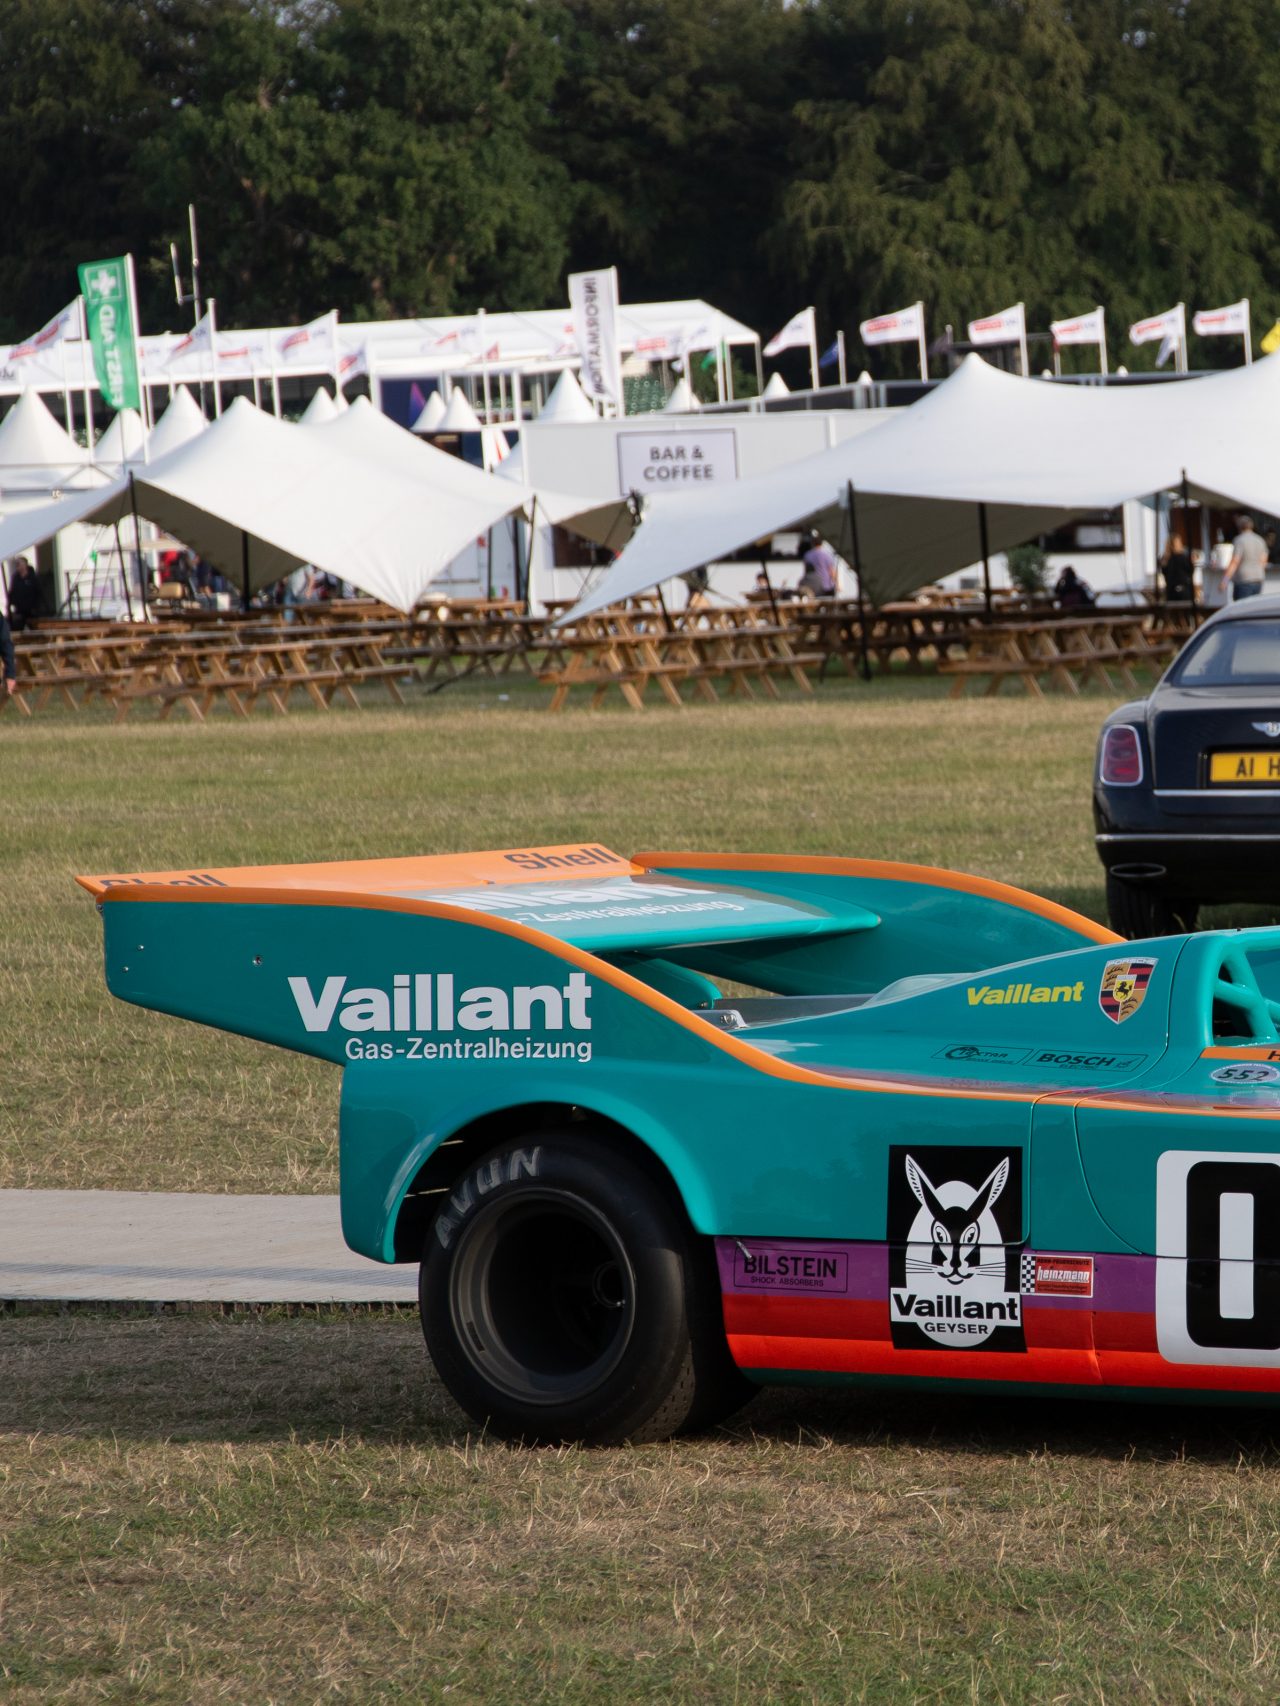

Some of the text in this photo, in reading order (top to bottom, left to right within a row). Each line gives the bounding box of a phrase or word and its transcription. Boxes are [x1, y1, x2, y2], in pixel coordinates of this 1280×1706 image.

[649, 445, 705, 461] BAR &
[643, 463, 714, 481] COFFEE
[503, 847, 621, 870] Shell
[287, 972, 592, 1032] Vaillant
[966, 981, 1085, 1007] Vaillant
[345, 1036, 593, 1063] Gas-Zentralheizung
[1036, 1053, 1117, 1067] BOSCH
[1217, 1068, 1270, 1082] 552
[434, 1145, 542, 1249] AVON
[743, 1254, 838, 1278] BILSTEIN
[1036, 1265, 1091, 1284] heinzmann
[892, 1293, 1019, 1321] Vaillant
[924, 1321, 989, 1335] GEYSER
